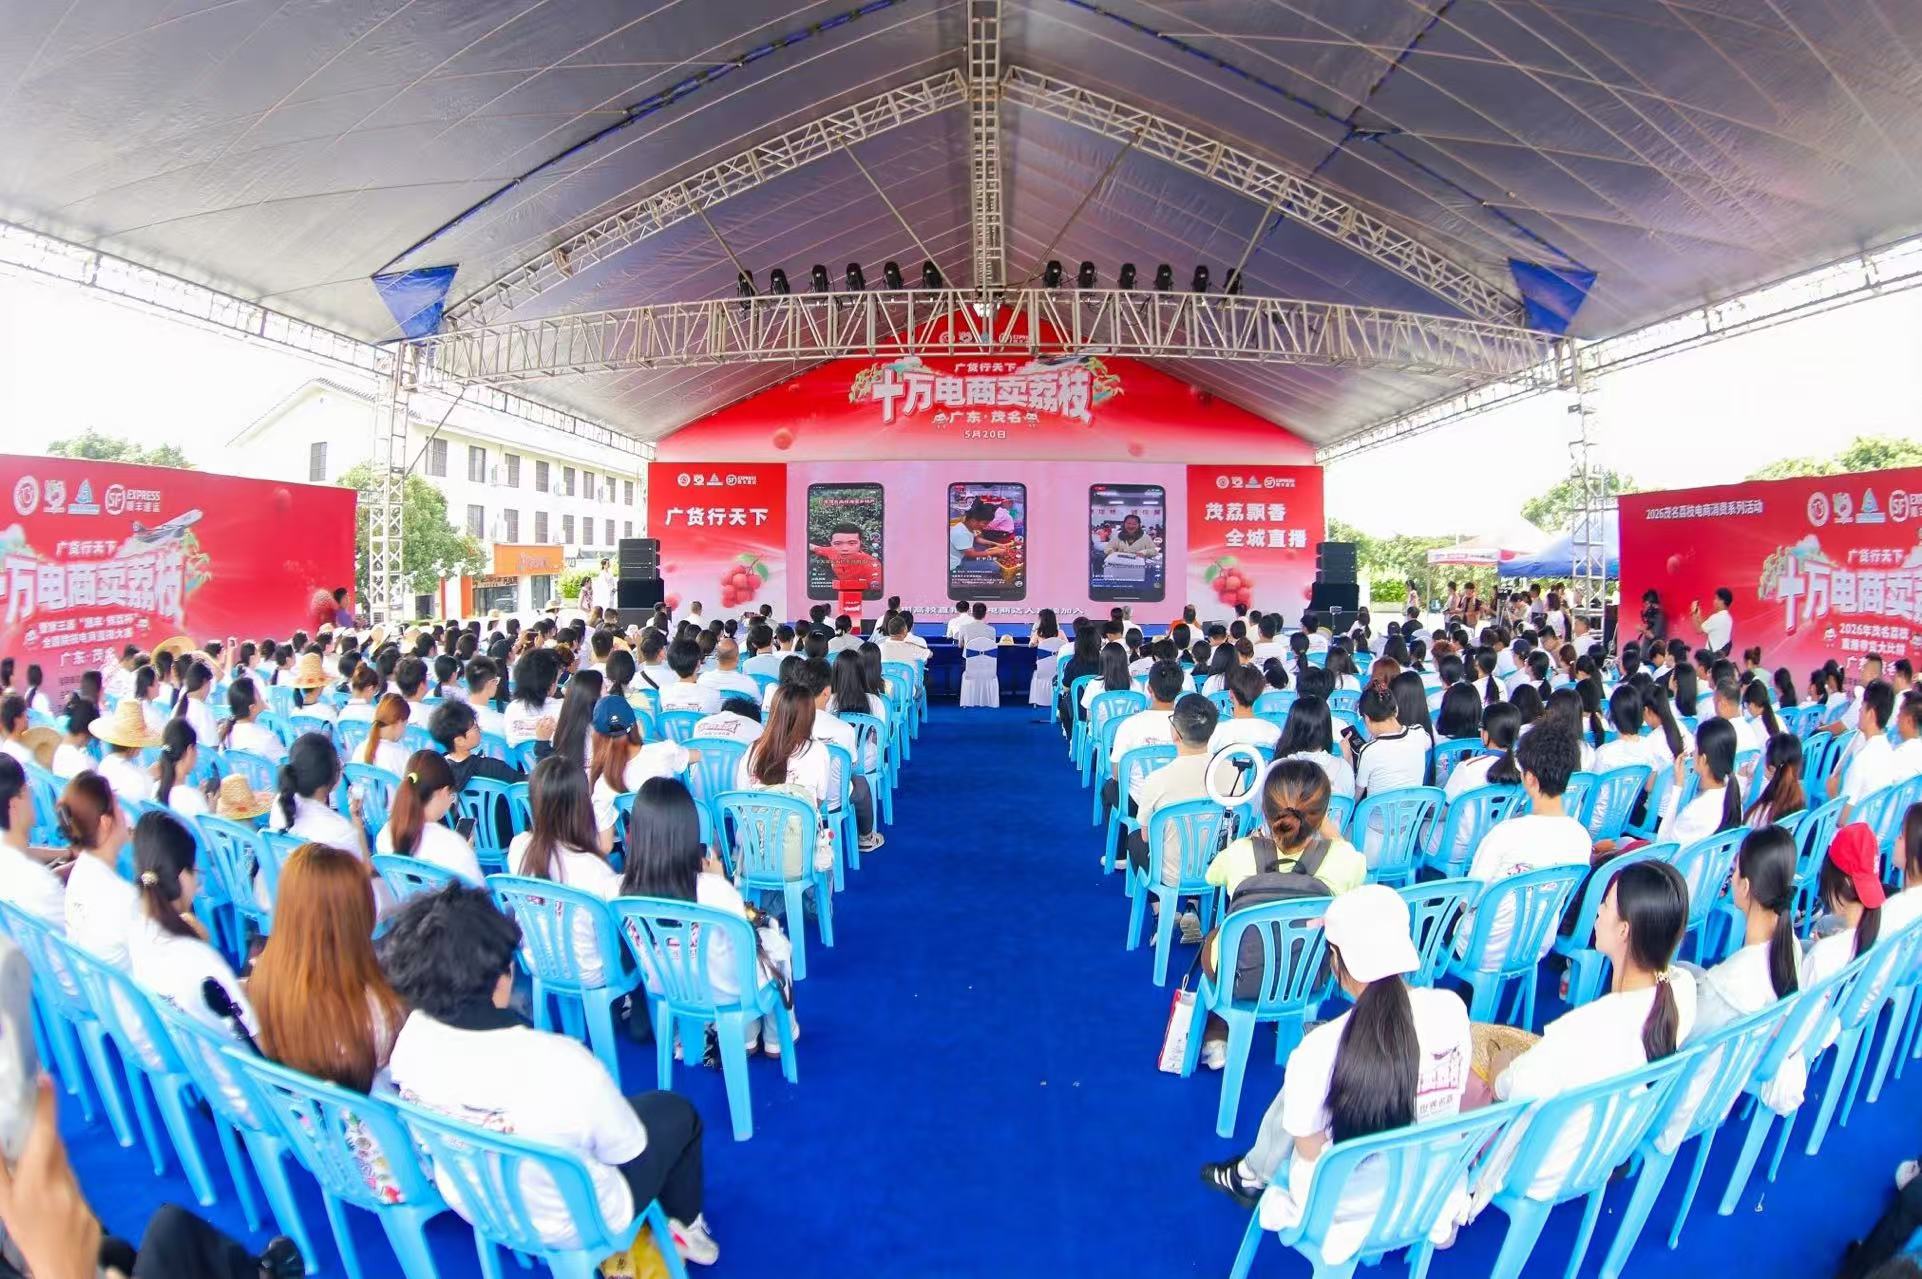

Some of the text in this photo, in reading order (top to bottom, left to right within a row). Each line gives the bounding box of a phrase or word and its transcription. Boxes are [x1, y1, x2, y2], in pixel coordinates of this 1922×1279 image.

[954, 362, 1017, 373] 广货行天下
[872, 366, 1093, 425] 十万电商卖荔枝
[964, 430, 1007, 440] 5月20日
[127, 490, 160, 501] EXPRESS
[665, 507, 768, 526] 广货行天下
[1204, 502, 1286, 521] 茂荔飘香
[1225, 528, 1307, 548] 全城直播
[56, 540, 117, 557] 广货行天下
[1847, 549, 1904, 564] 广货行天下
[0, 551, 185, 629] 万电商卖荔枝
